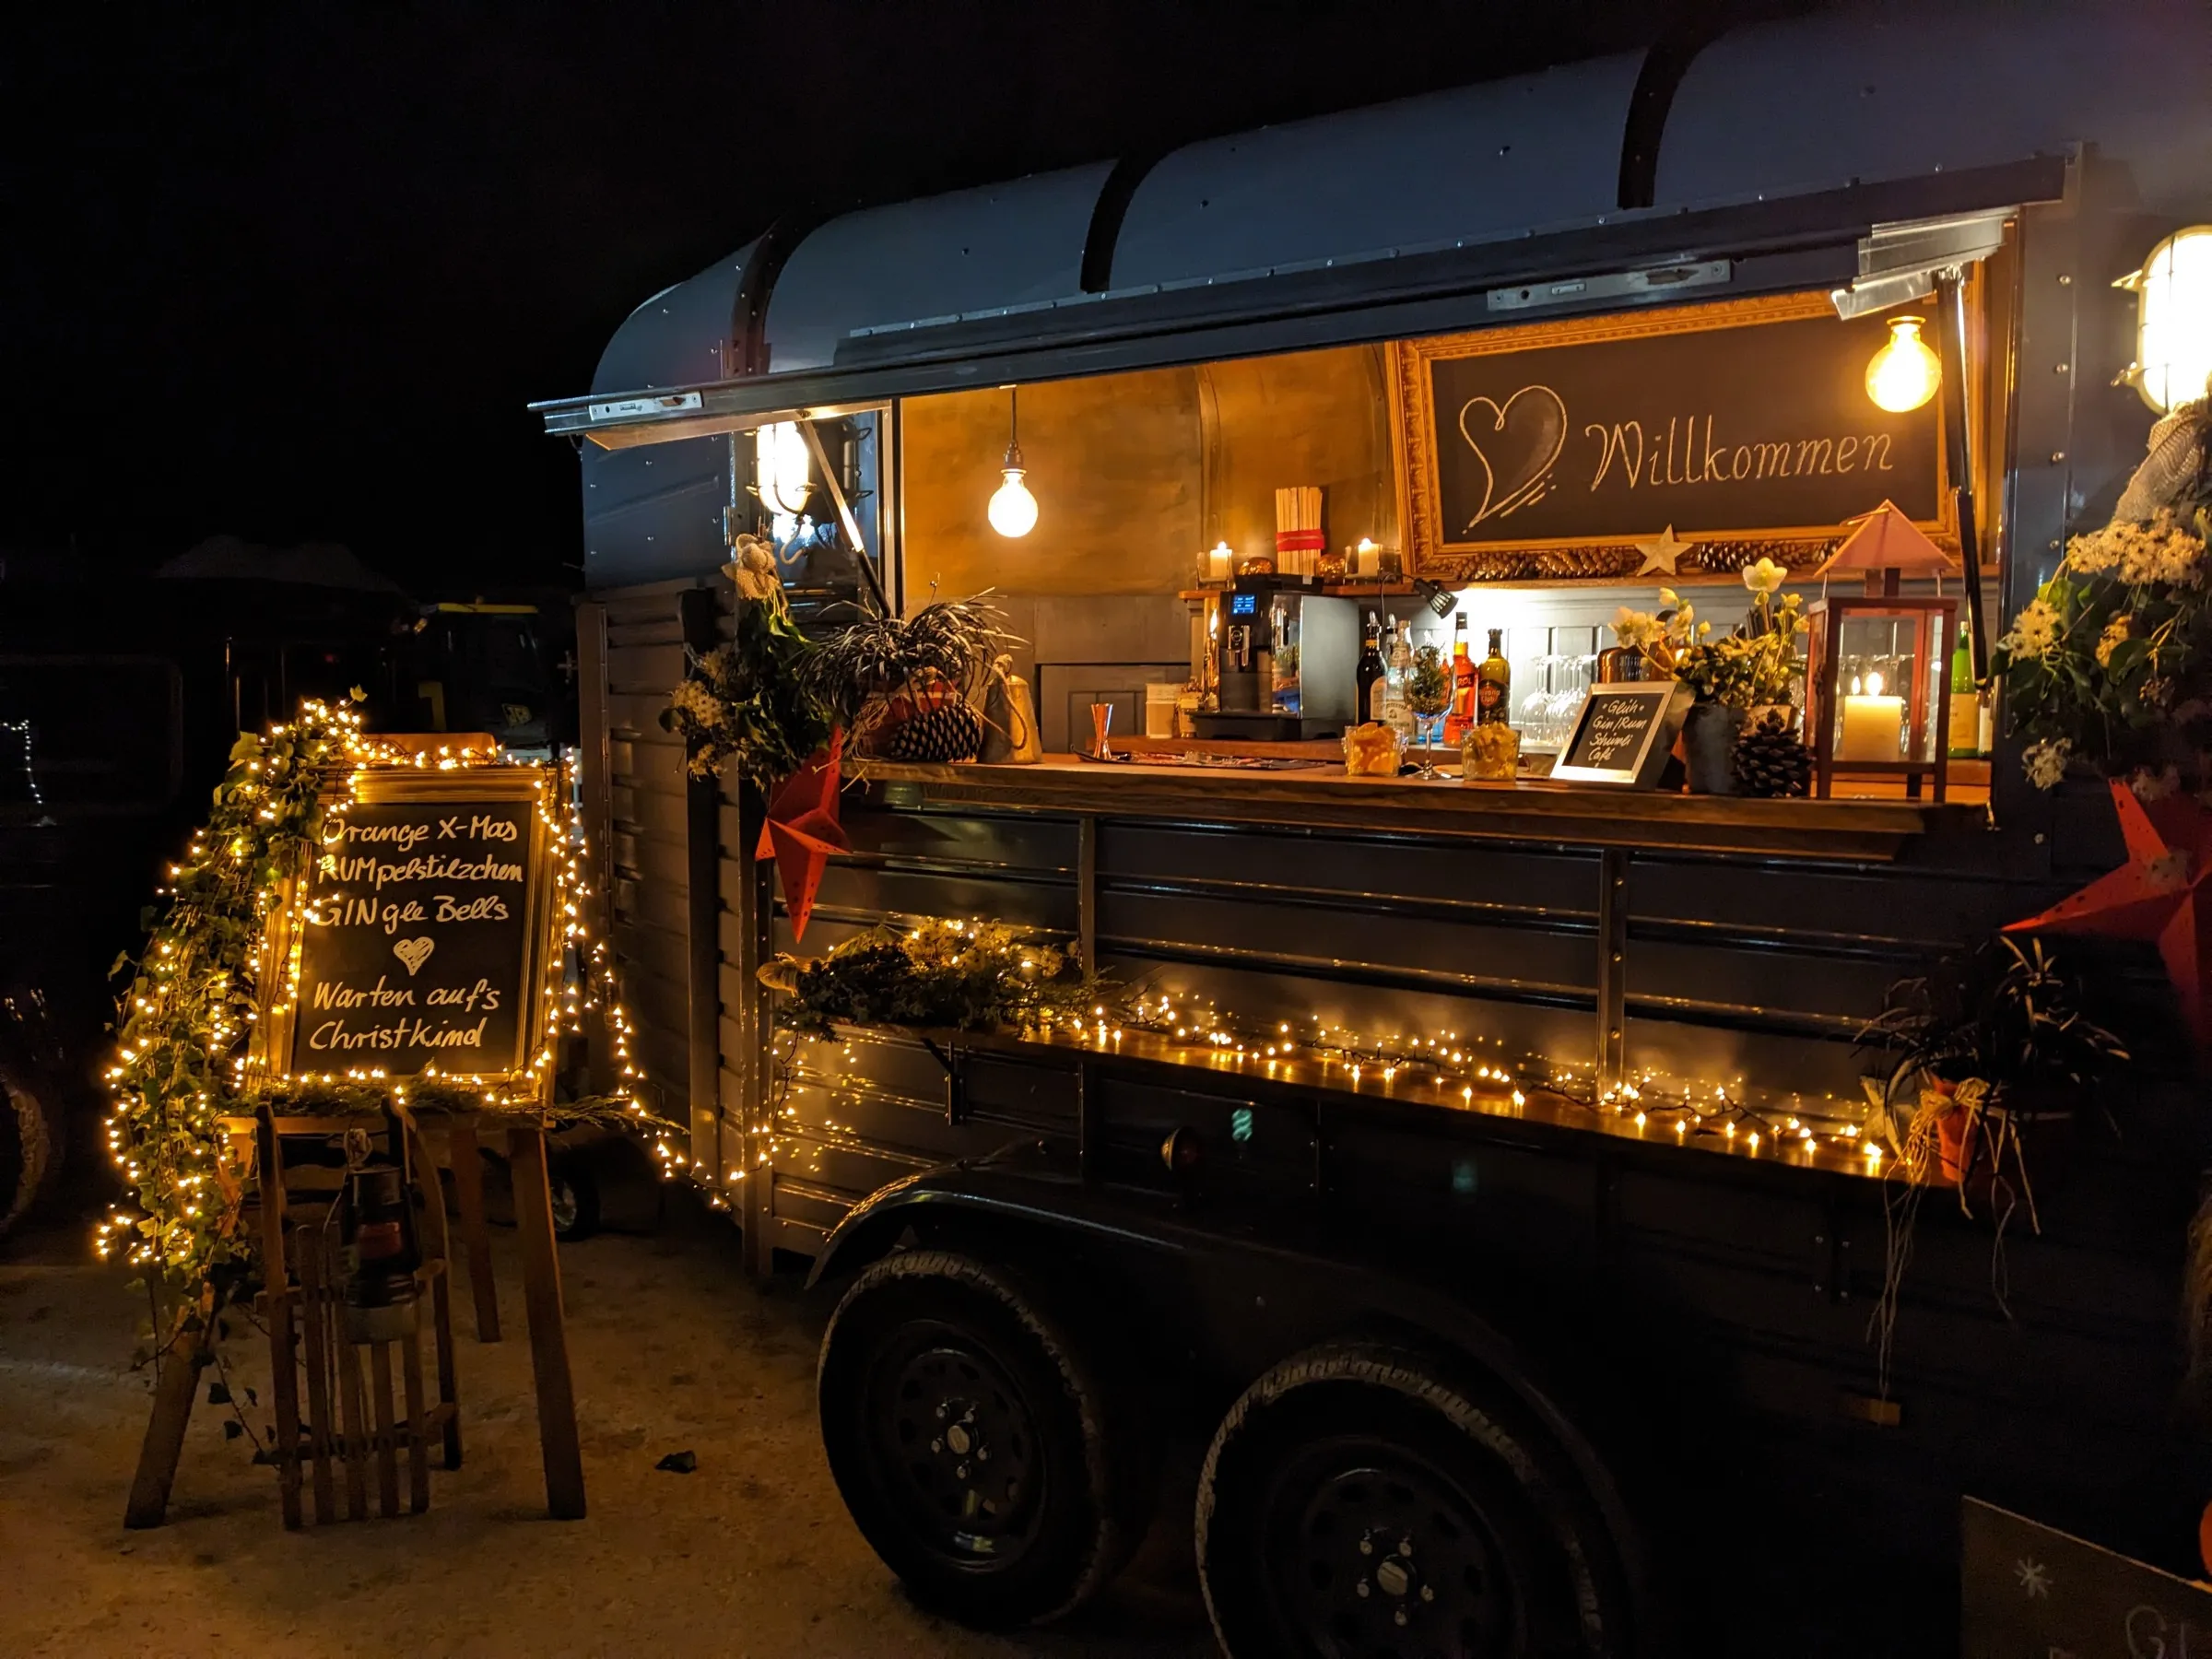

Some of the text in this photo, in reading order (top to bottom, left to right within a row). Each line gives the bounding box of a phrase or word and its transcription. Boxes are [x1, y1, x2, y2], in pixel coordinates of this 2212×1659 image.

[1584, 414, 1894, 493] Willkommen
[1593, 714, 1648, 732] Gin/Rum
[1587, 747, 1616, 769] Café
[323, 815, 518, 853] Orange X-Mas
[432, 895, 510, 923] Bells
[313, 974, 501, 1013] Warten auf's
